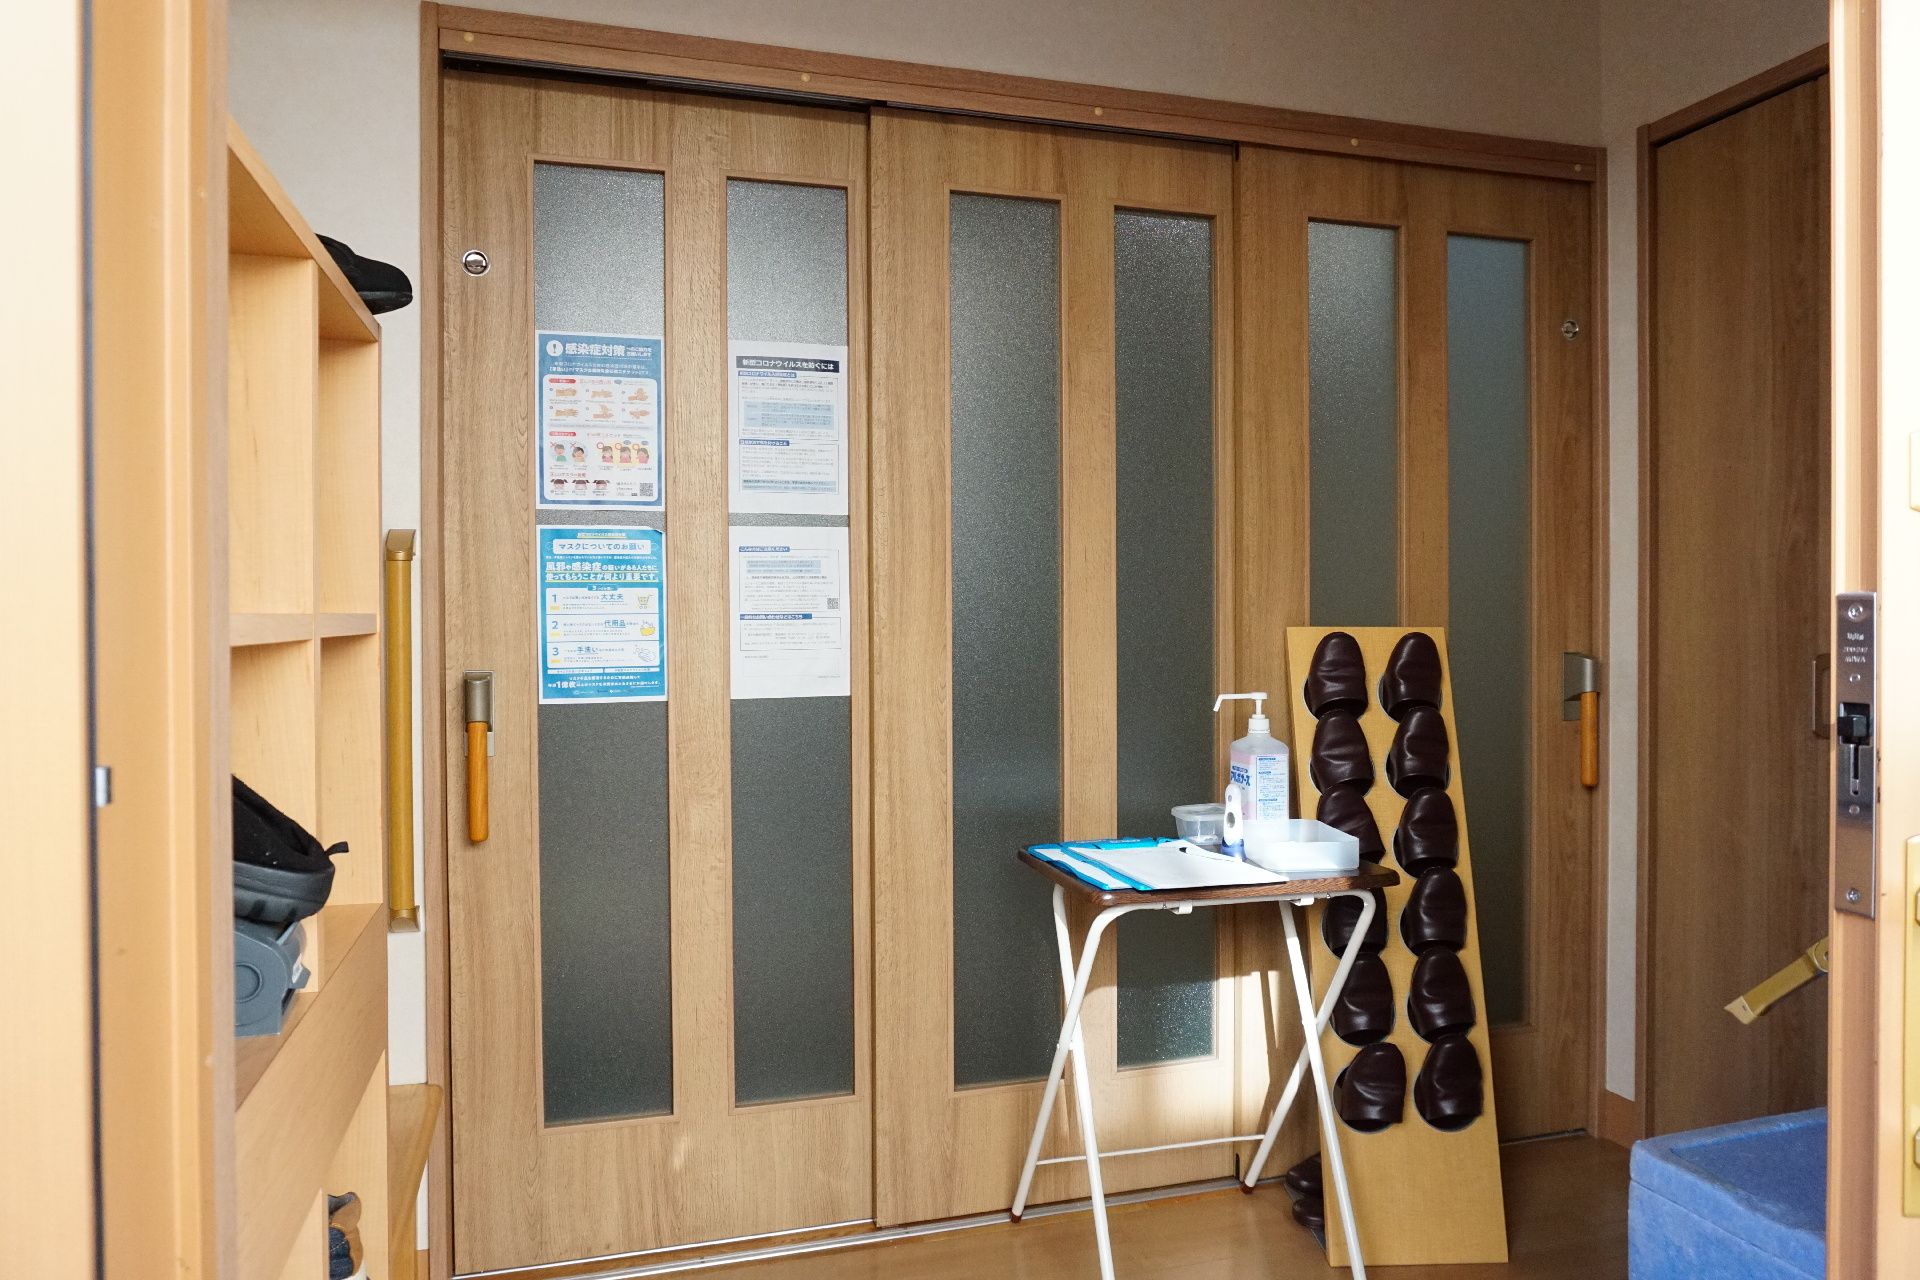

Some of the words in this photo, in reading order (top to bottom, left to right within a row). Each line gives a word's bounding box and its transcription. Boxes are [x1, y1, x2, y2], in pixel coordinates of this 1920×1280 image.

[565, 342, 625, 357] 感染症対策
[742, 358, 835, 371] 新型コロナウイルスを防ぐには
[558, 542, 645, 551] マスクについてのお願い
[545, 572, 659, 581] 使ってもらうことが何より重要です。
[551, 594, 557, 603] 1
[600, 592, 624, 600] 大丈夫
[551, 620, 558, 630] 2
[604, 619, 626, 627] 代用品
[552, 647, 559, 656] 3
